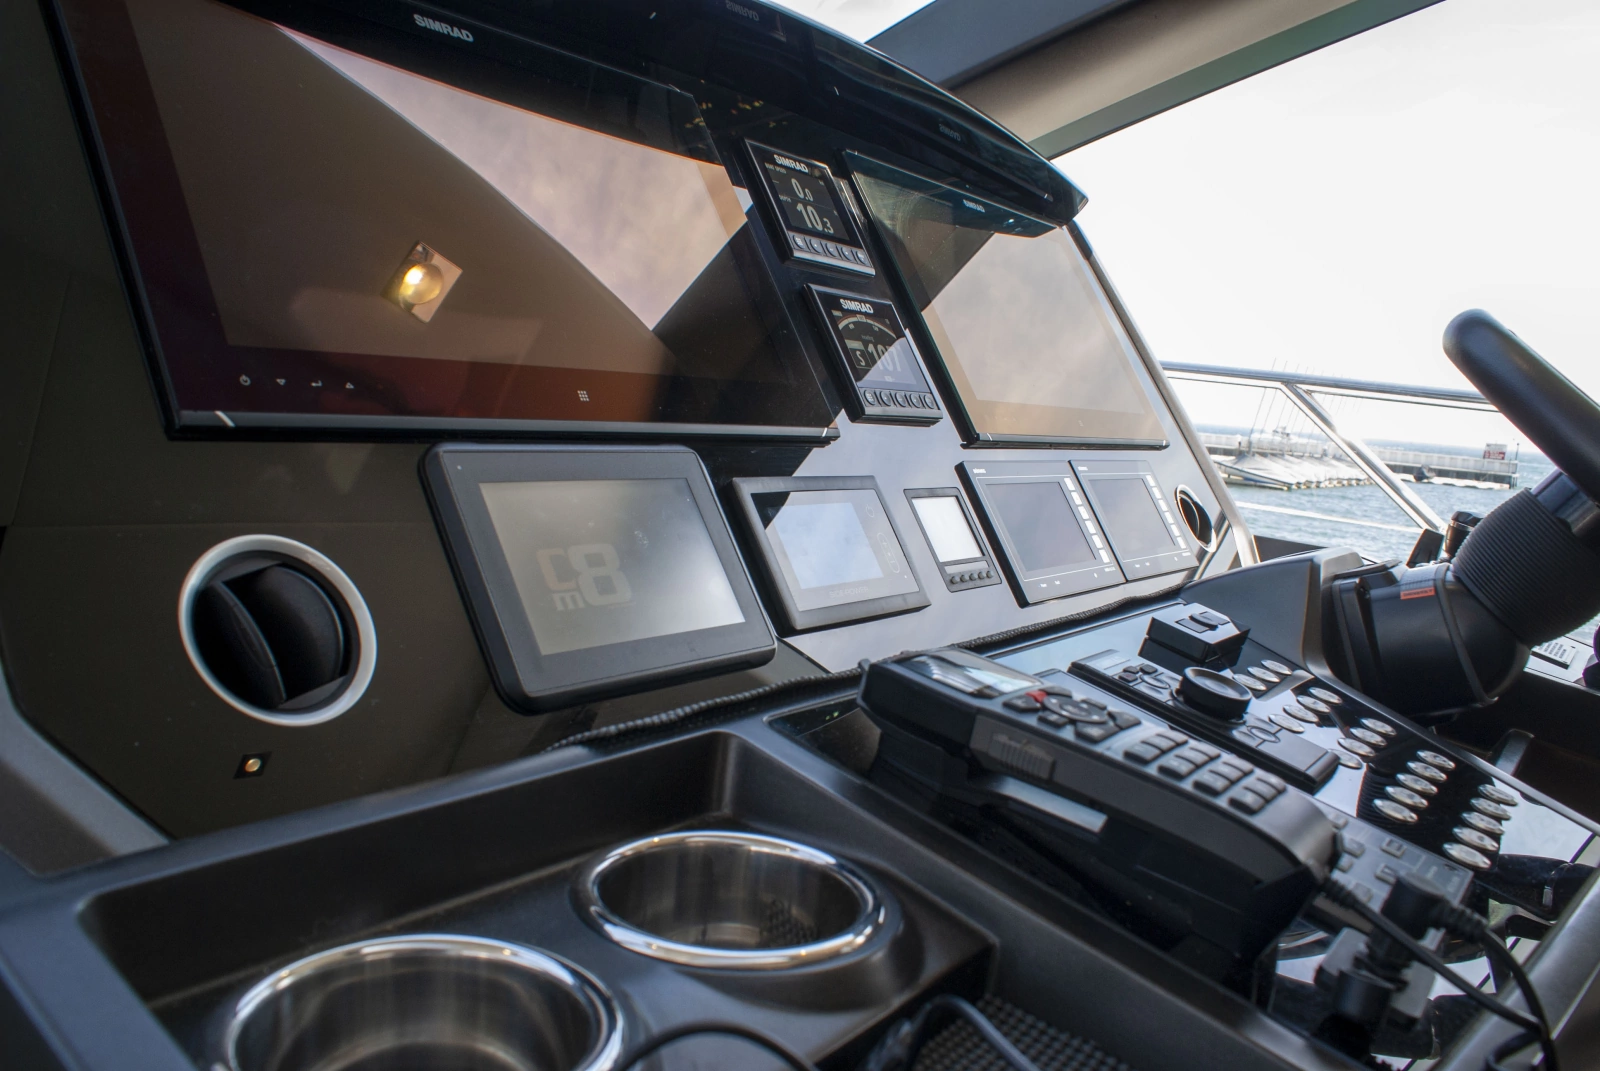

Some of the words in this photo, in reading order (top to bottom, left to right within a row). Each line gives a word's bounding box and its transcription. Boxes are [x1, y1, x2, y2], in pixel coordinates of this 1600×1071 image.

[413, 13, 474, 42] SIMRAD
[773, 154, 809, 173] SIMRAD
[791, 178, 814, 202] 0.0
[962, 199, 986, 212] SIMRAD
[796, 203, 835, 234] 10.3
[840, 299, 874, 314] SIMRAD
